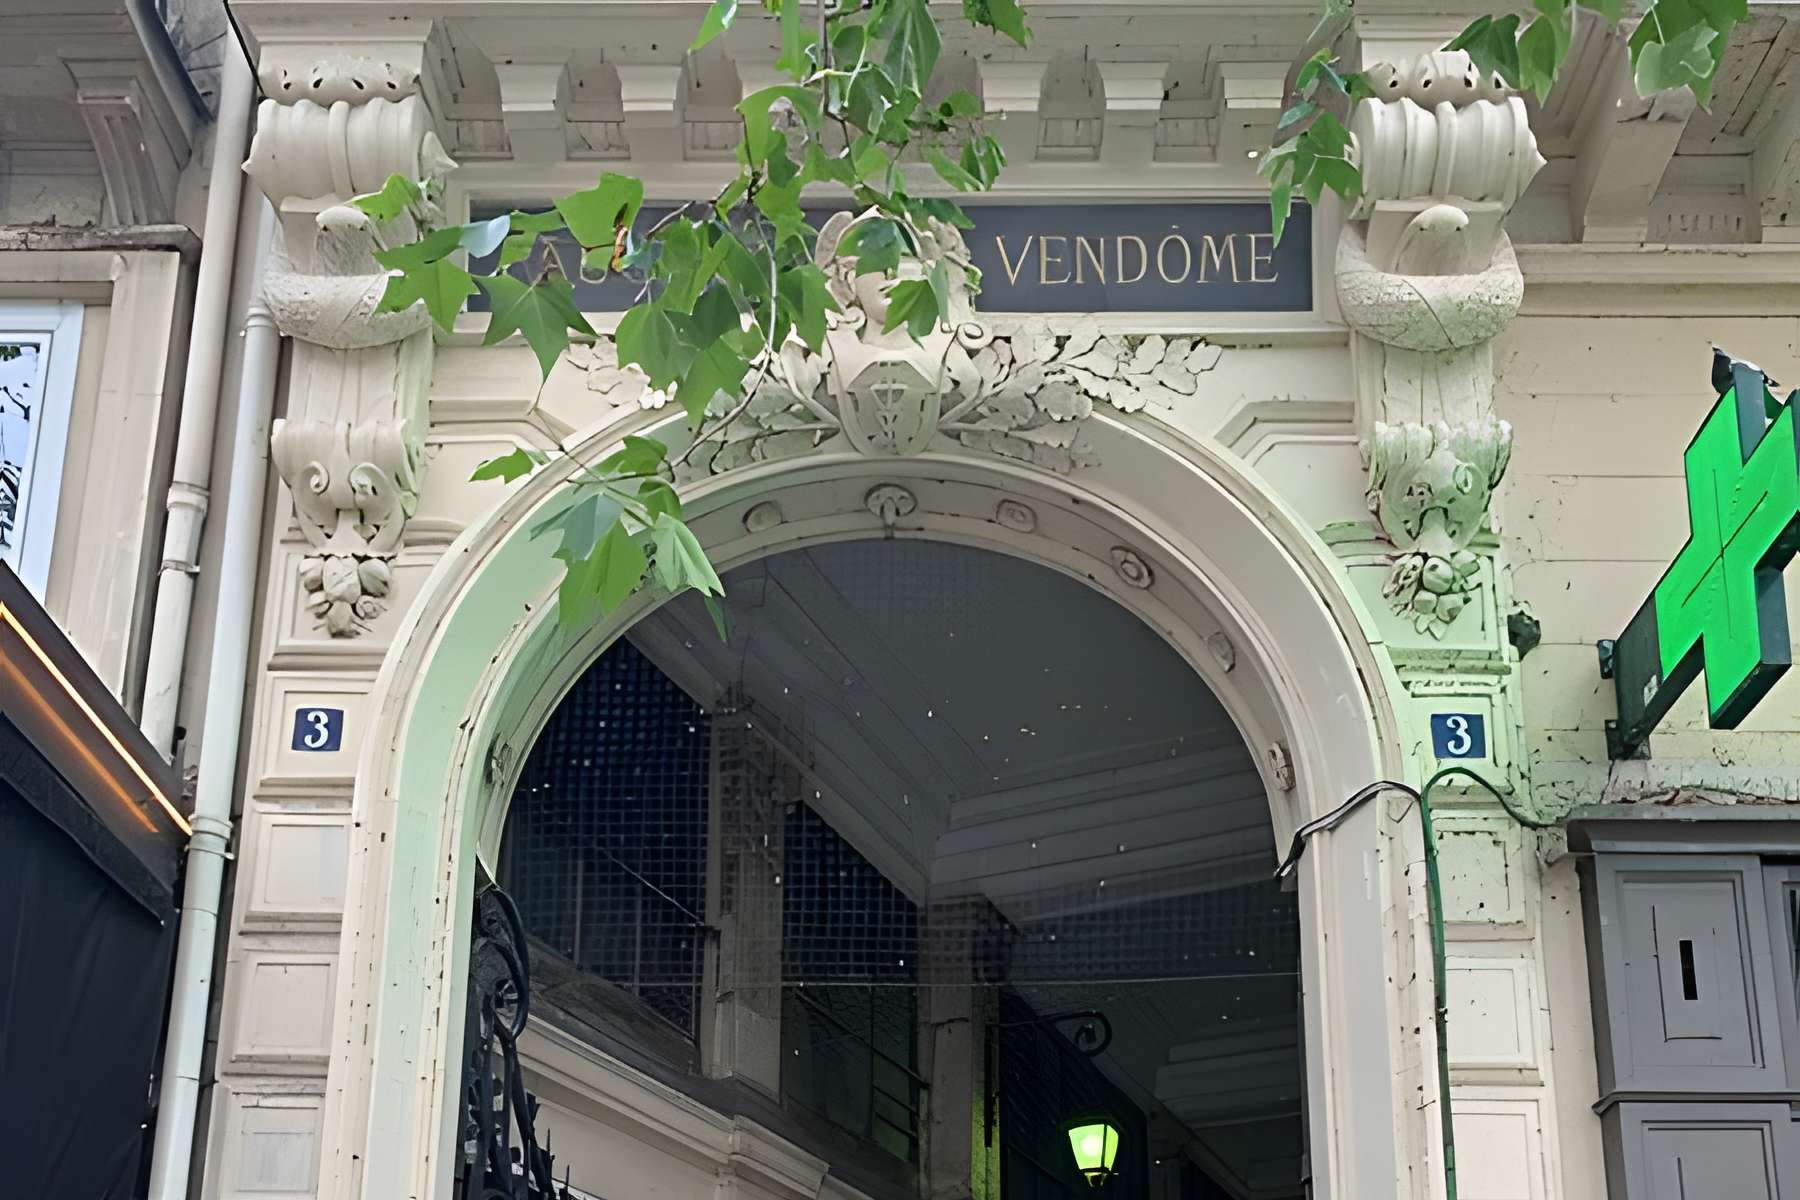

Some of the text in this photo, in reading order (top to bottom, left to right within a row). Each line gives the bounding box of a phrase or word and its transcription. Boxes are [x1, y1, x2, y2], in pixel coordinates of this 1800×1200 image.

[995, 224, 1280, 286] VENDÔME
[304, 710, 329, 749] 3
[1446, 715, 1472, 755] 3
